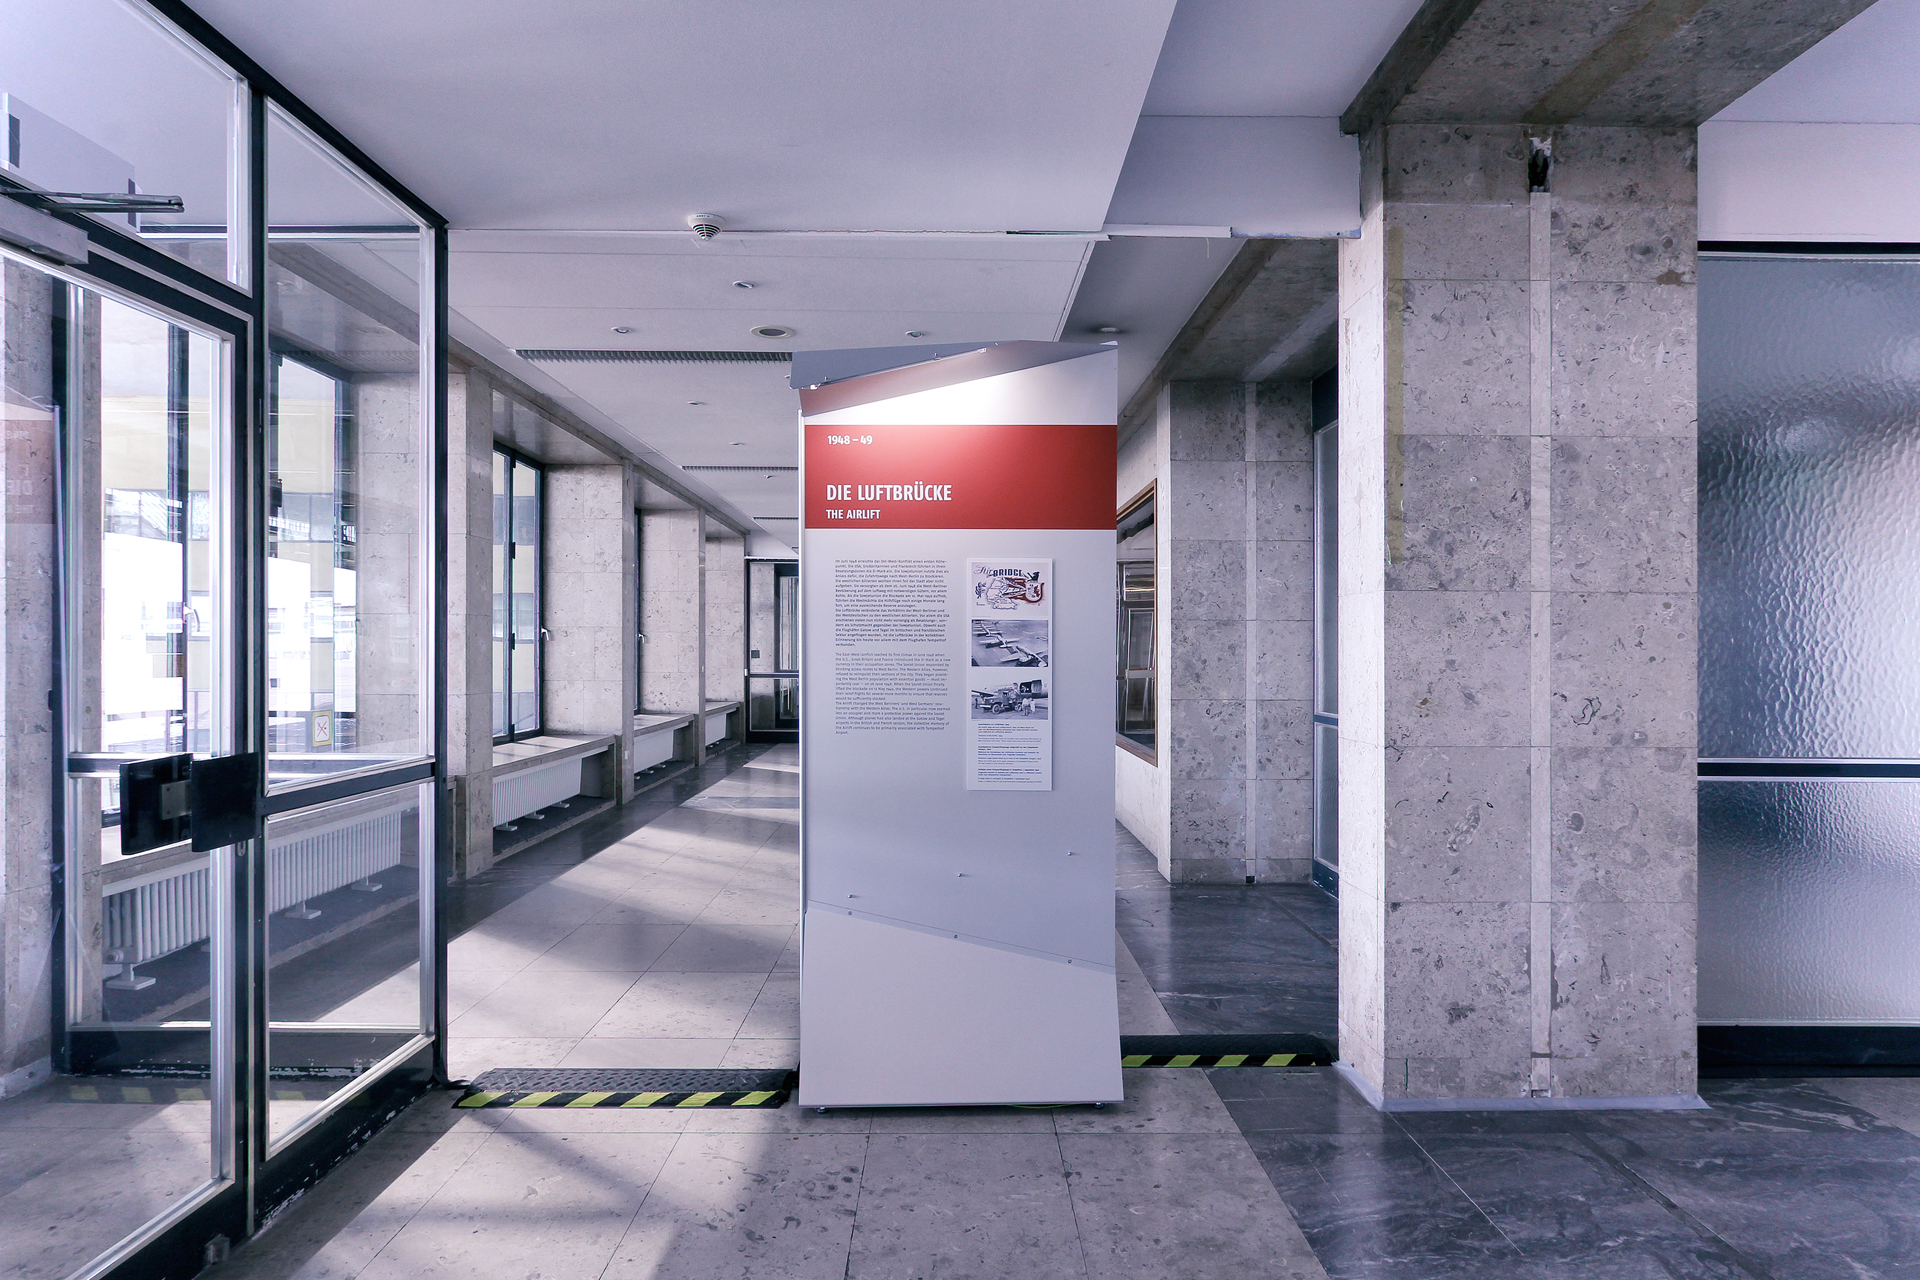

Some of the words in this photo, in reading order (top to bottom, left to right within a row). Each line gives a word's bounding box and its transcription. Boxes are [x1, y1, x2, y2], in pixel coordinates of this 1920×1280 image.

[827, 435, 851, 445] 1948
[860, 435, 873, 445] 49
[826, 484, 852, 501] DIE
[857, 480, 952, 501] LUFTBRÜCKE
[826, 509, 844, 520] THE
[846, 509, 882, 520] AIRLIFT
[993, 568, 1023, 578] BRIDGE
